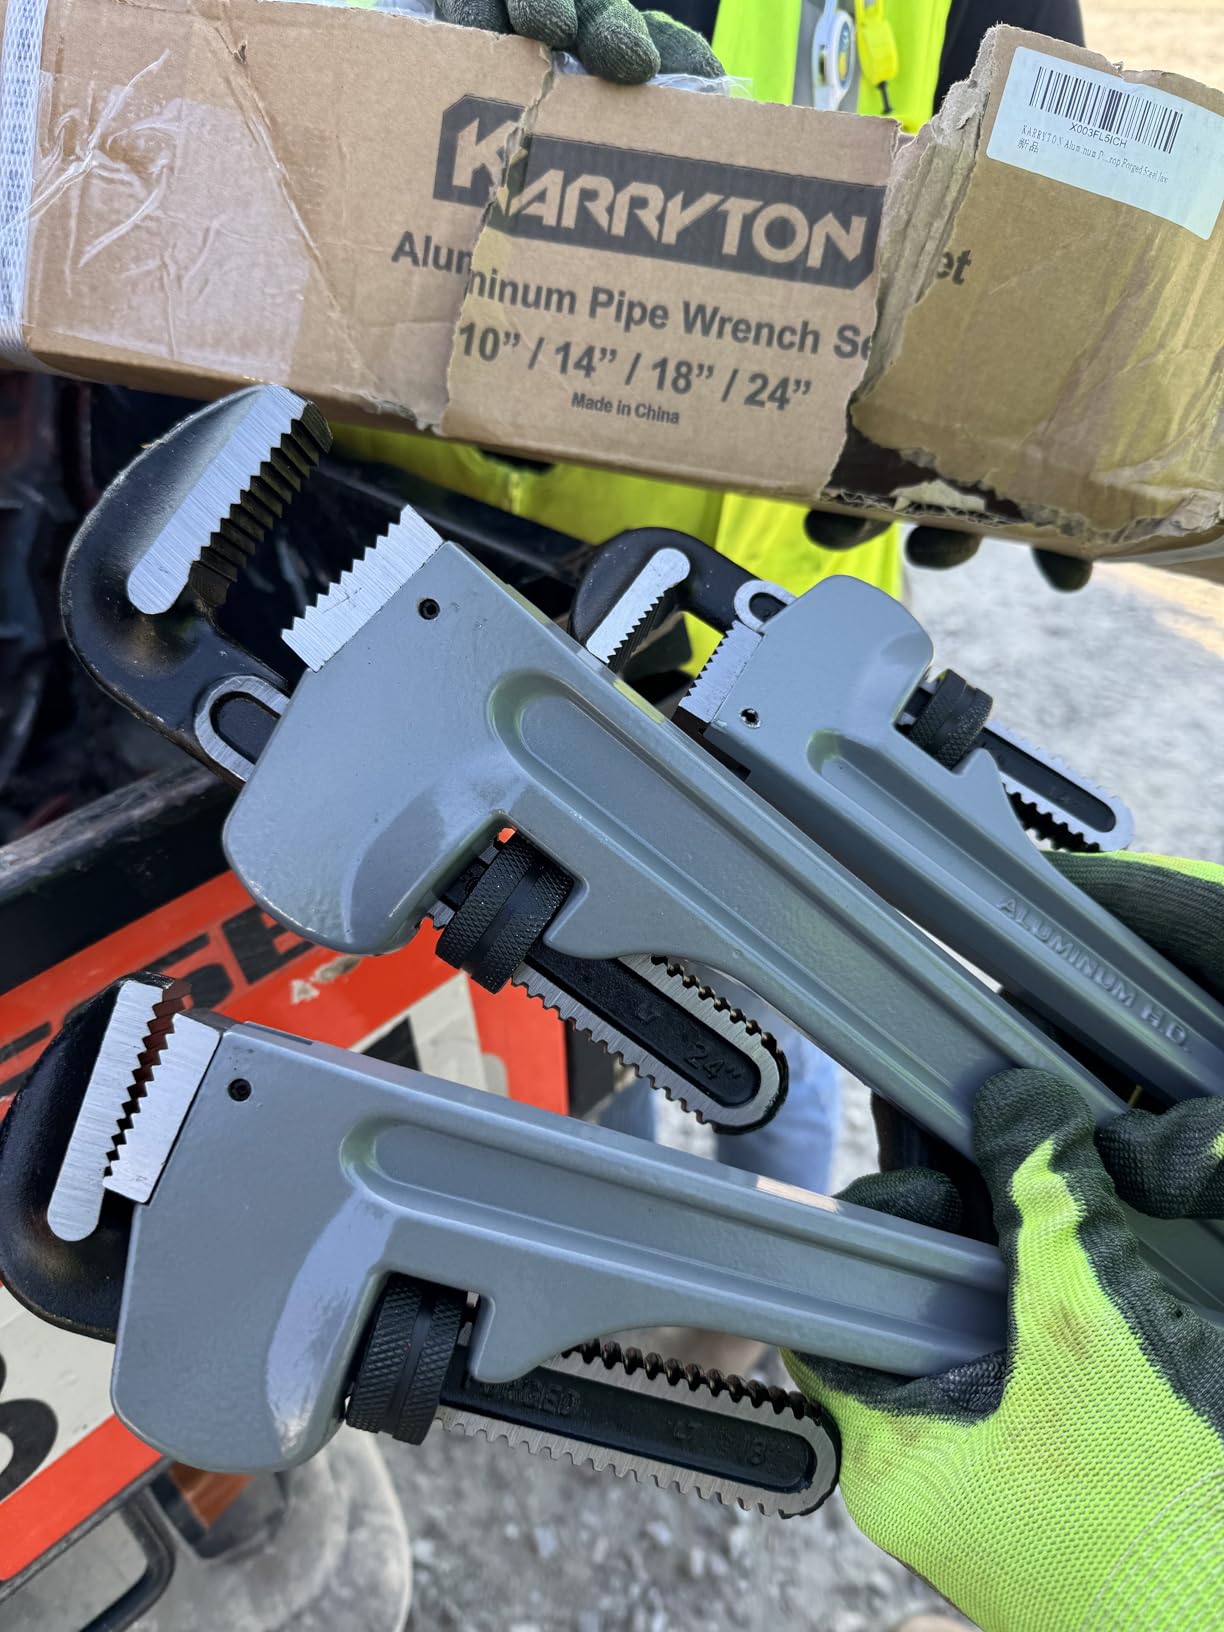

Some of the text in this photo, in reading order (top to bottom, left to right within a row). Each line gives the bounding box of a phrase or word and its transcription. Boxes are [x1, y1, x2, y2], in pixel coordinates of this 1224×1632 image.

[1069, 122, 1128, 148] X003FL5ICH
[451, 116, 868, 270] KARRYTON
[391, 231, 577, 315] Aluminum
[588, 285, 670, 333] Pipe
[682, 300, 821, 354] Wrench
[527, 336, 545, 370] /
[624, 352, 642, 386] /
[721, 368, 739, 402] /
[571, 391, 681, 425] Made in China
[997, 898, 1137, 1008] ALUMINUM
